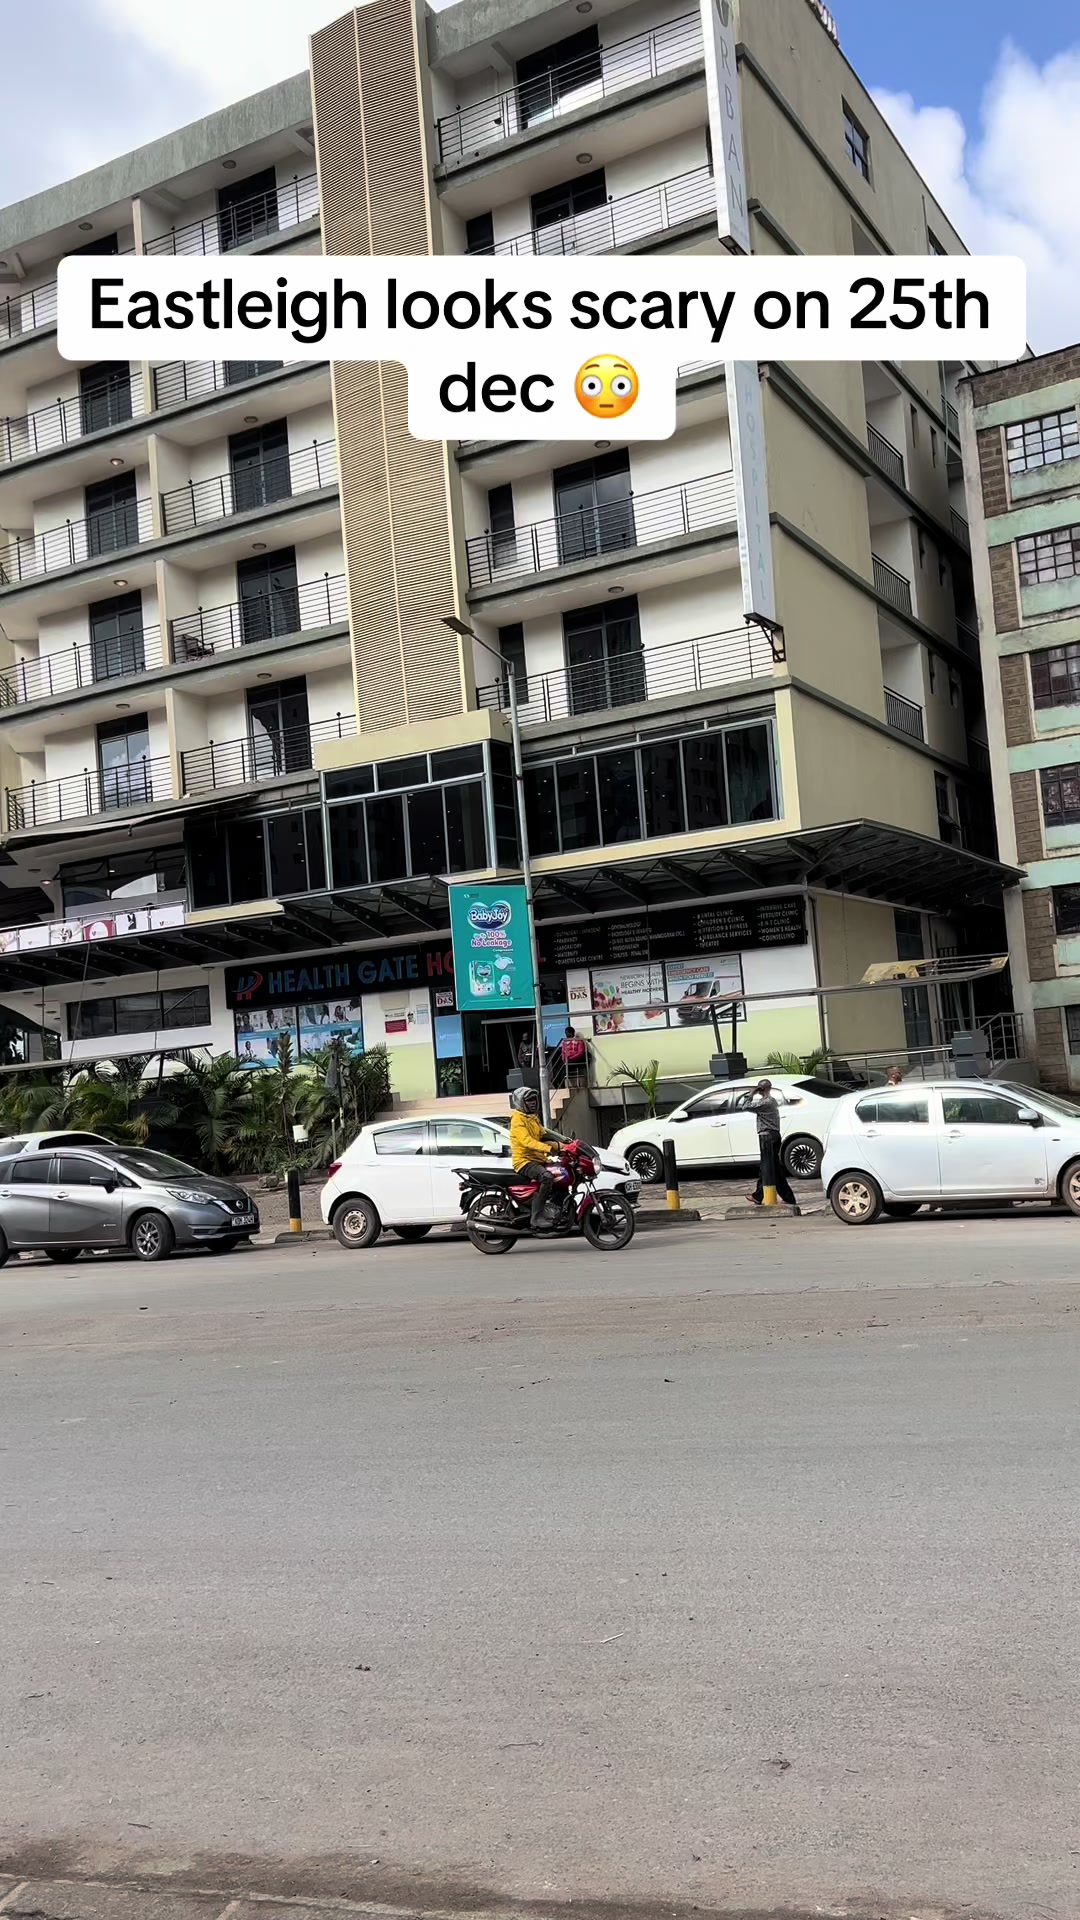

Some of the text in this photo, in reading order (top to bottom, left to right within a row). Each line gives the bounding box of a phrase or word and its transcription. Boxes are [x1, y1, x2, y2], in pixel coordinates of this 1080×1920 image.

[470, 908, 508, 922] BabyJoy
[482, 940, 512, 948] Leakage
[268, 964, 350, 994] HEALTH
[357, 954, 419, 984] GATE
[620, 980, 645, 989] BEGINS
[646, 978, 664, 987] WITH
